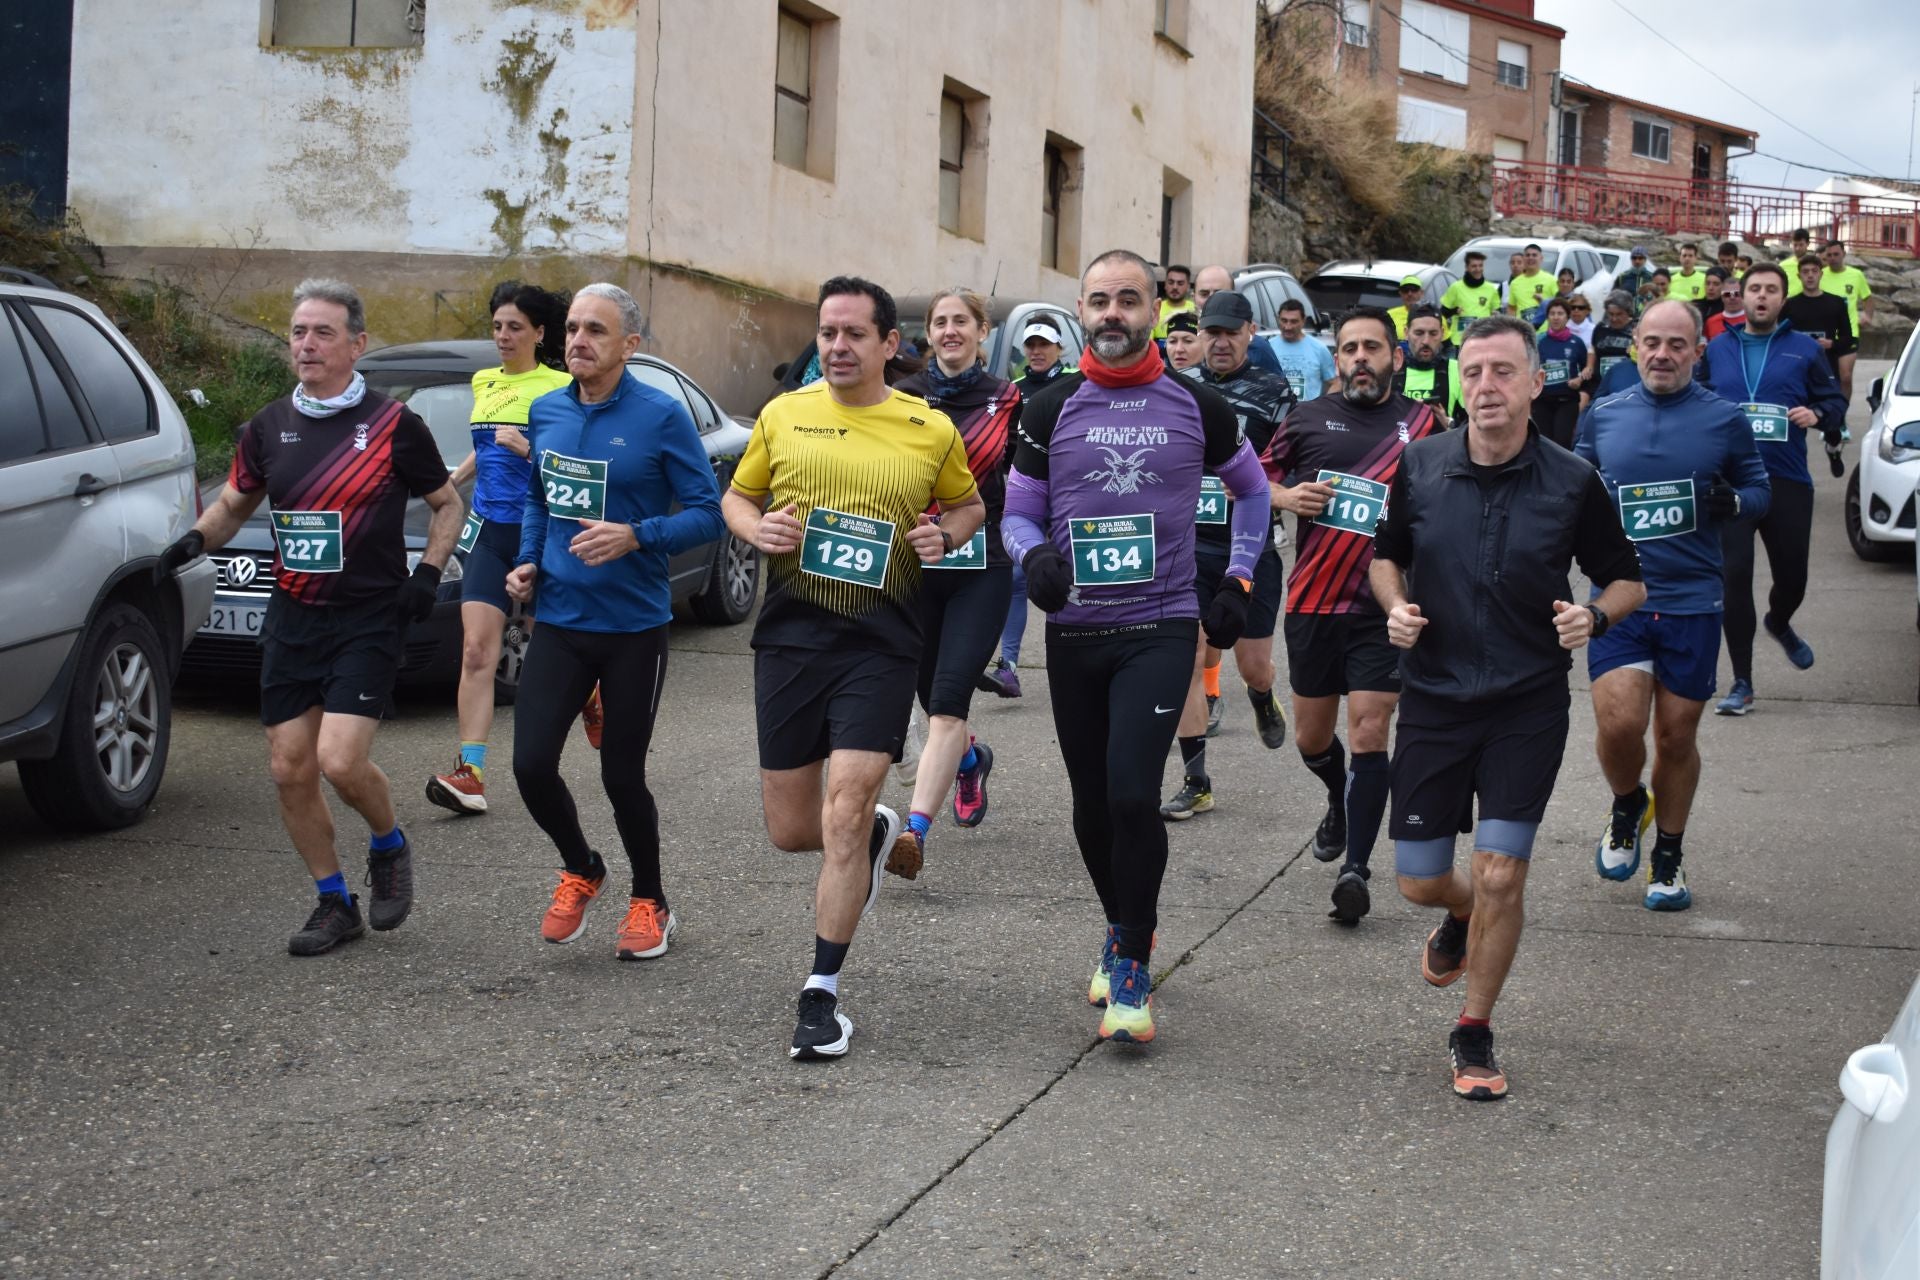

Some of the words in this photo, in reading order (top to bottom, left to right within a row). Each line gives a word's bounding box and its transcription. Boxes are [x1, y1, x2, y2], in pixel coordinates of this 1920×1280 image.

[1545, 370, 1565, 381] 285
[794, 425, 835, 434] PROPÓSITO
[1085, 432, 1168, 446] MONCAYO
[547, 481, 591, 509] 224
[1327, 497, 1370, 523] 110
[1633, 506, 1683, 530] 240
[285, 538, 328, 560] 227
[817, 540, 873, 572] 129
[1086, 546, 1142, 572] 134
[1100, 628, 1117, 636] QUE
[1119, 623, 1157, 633] CORRER
